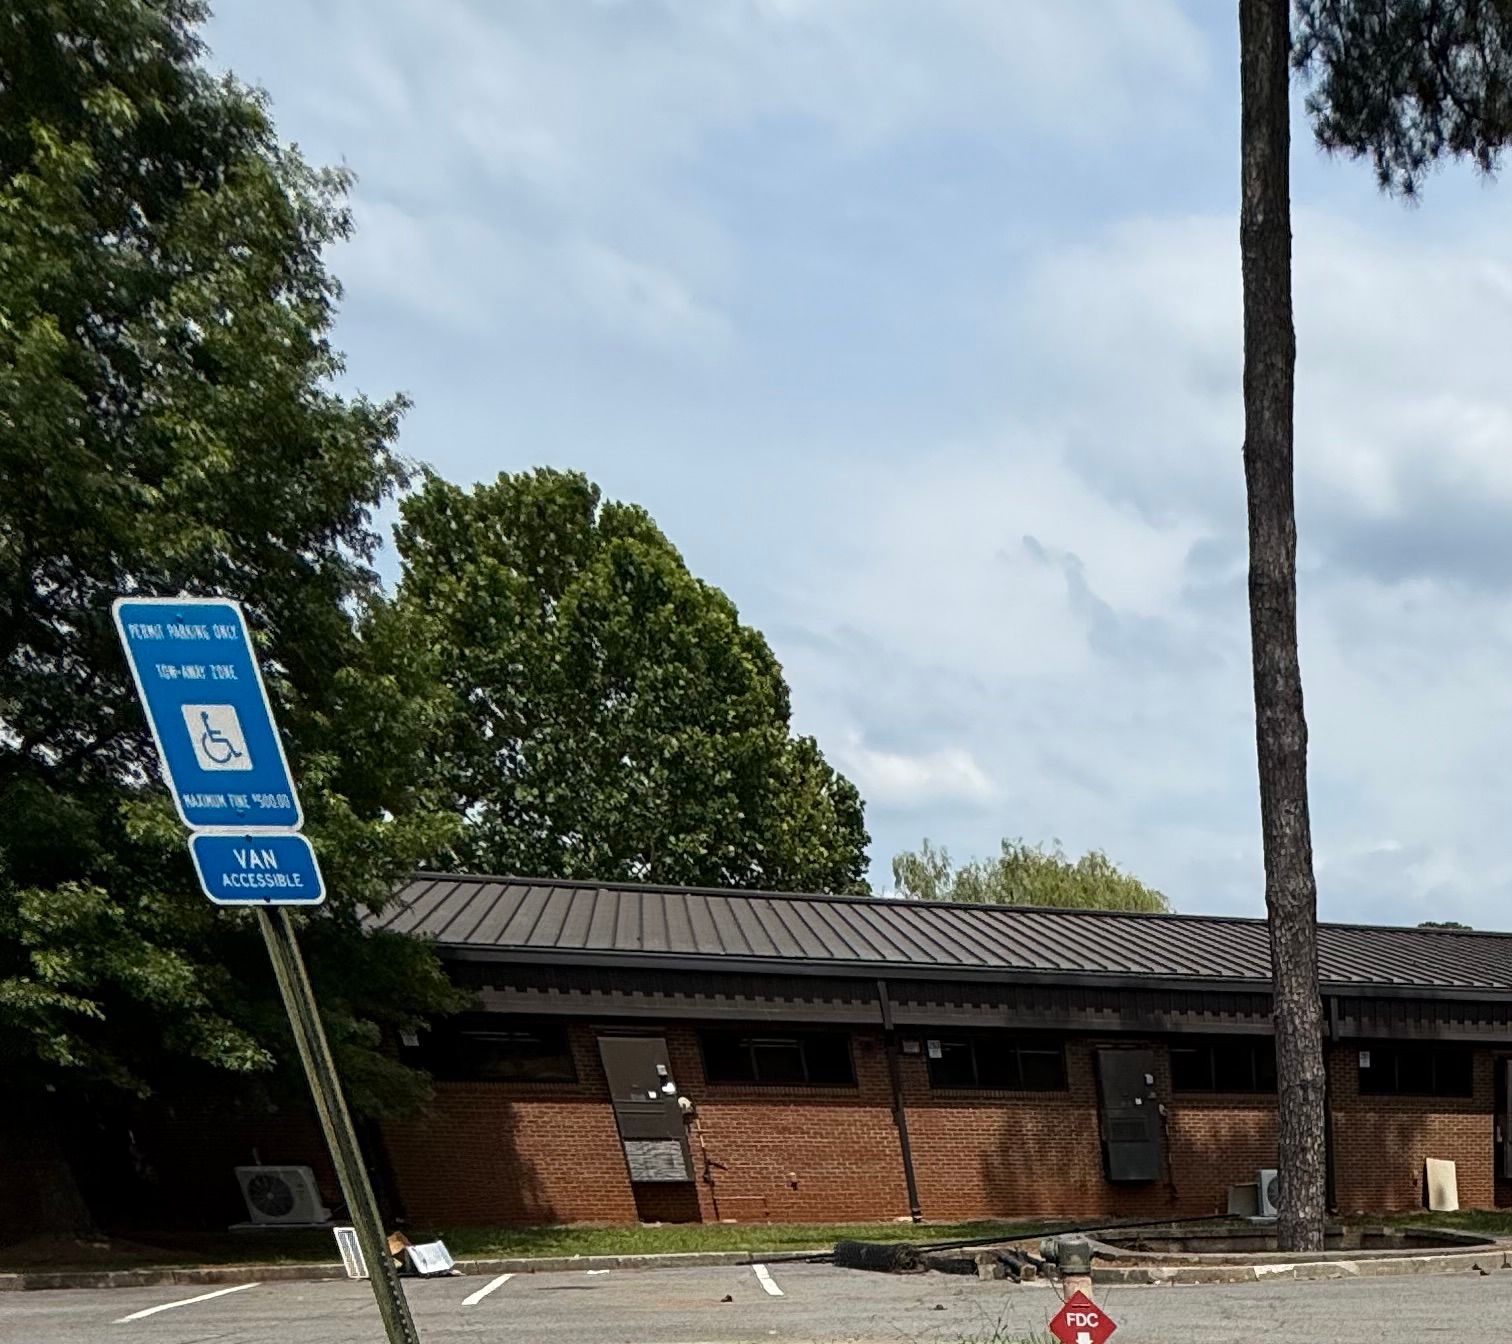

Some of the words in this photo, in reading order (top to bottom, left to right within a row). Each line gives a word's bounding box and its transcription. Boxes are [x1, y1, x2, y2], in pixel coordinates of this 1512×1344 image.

[128, 624, 164, 640] PERMIT
[166, 623, 210, 640] PARKING
[211, 623, 239, 640] ONLY
[156, 664, 206, 680] TOW-AWAY
[208, 663, 238, 680] ZONE
[182, 793, 228, 809] MAXIMUM
[227, 793, 251, 809] FINE
[232, 848, 278, 869] VAN
[222, 873, 305, 888] ACCESSIBLE
[1066, 1312, 1099, 1328] FDC
